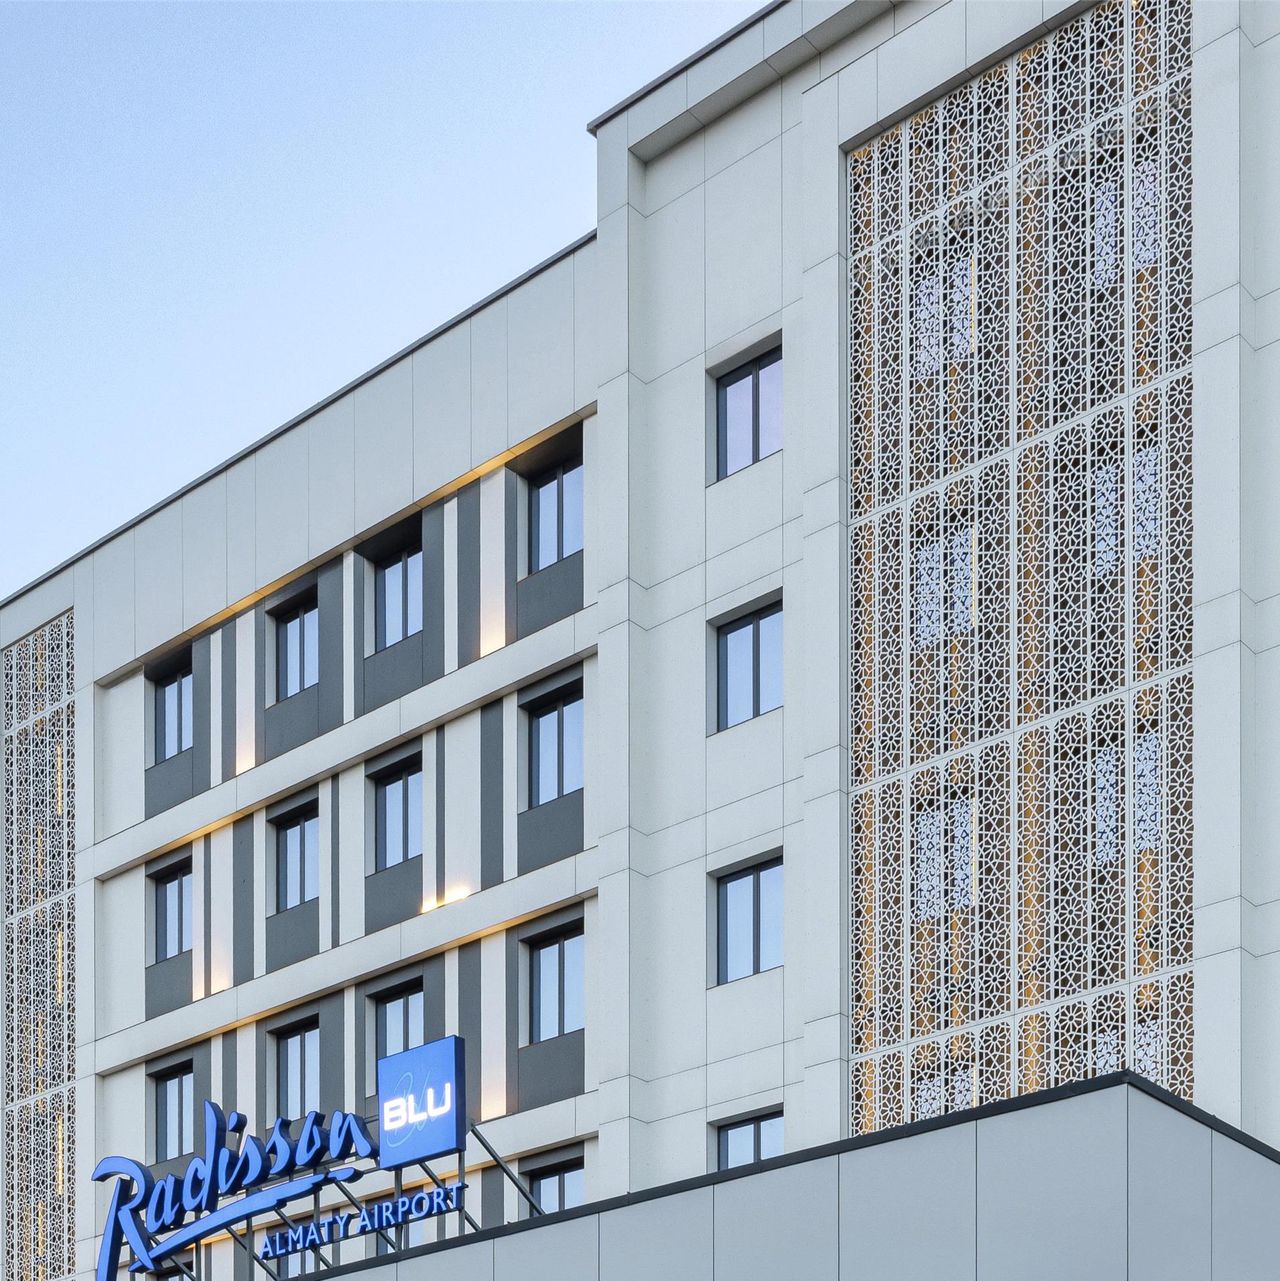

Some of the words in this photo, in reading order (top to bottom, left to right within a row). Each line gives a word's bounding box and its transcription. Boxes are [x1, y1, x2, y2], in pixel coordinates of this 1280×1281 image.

[383, 1082, 452, 1131] BLU
[260, 1212, 353, 1260] ALMATY
[357, 1182, 468, 1233] AIRPORT
